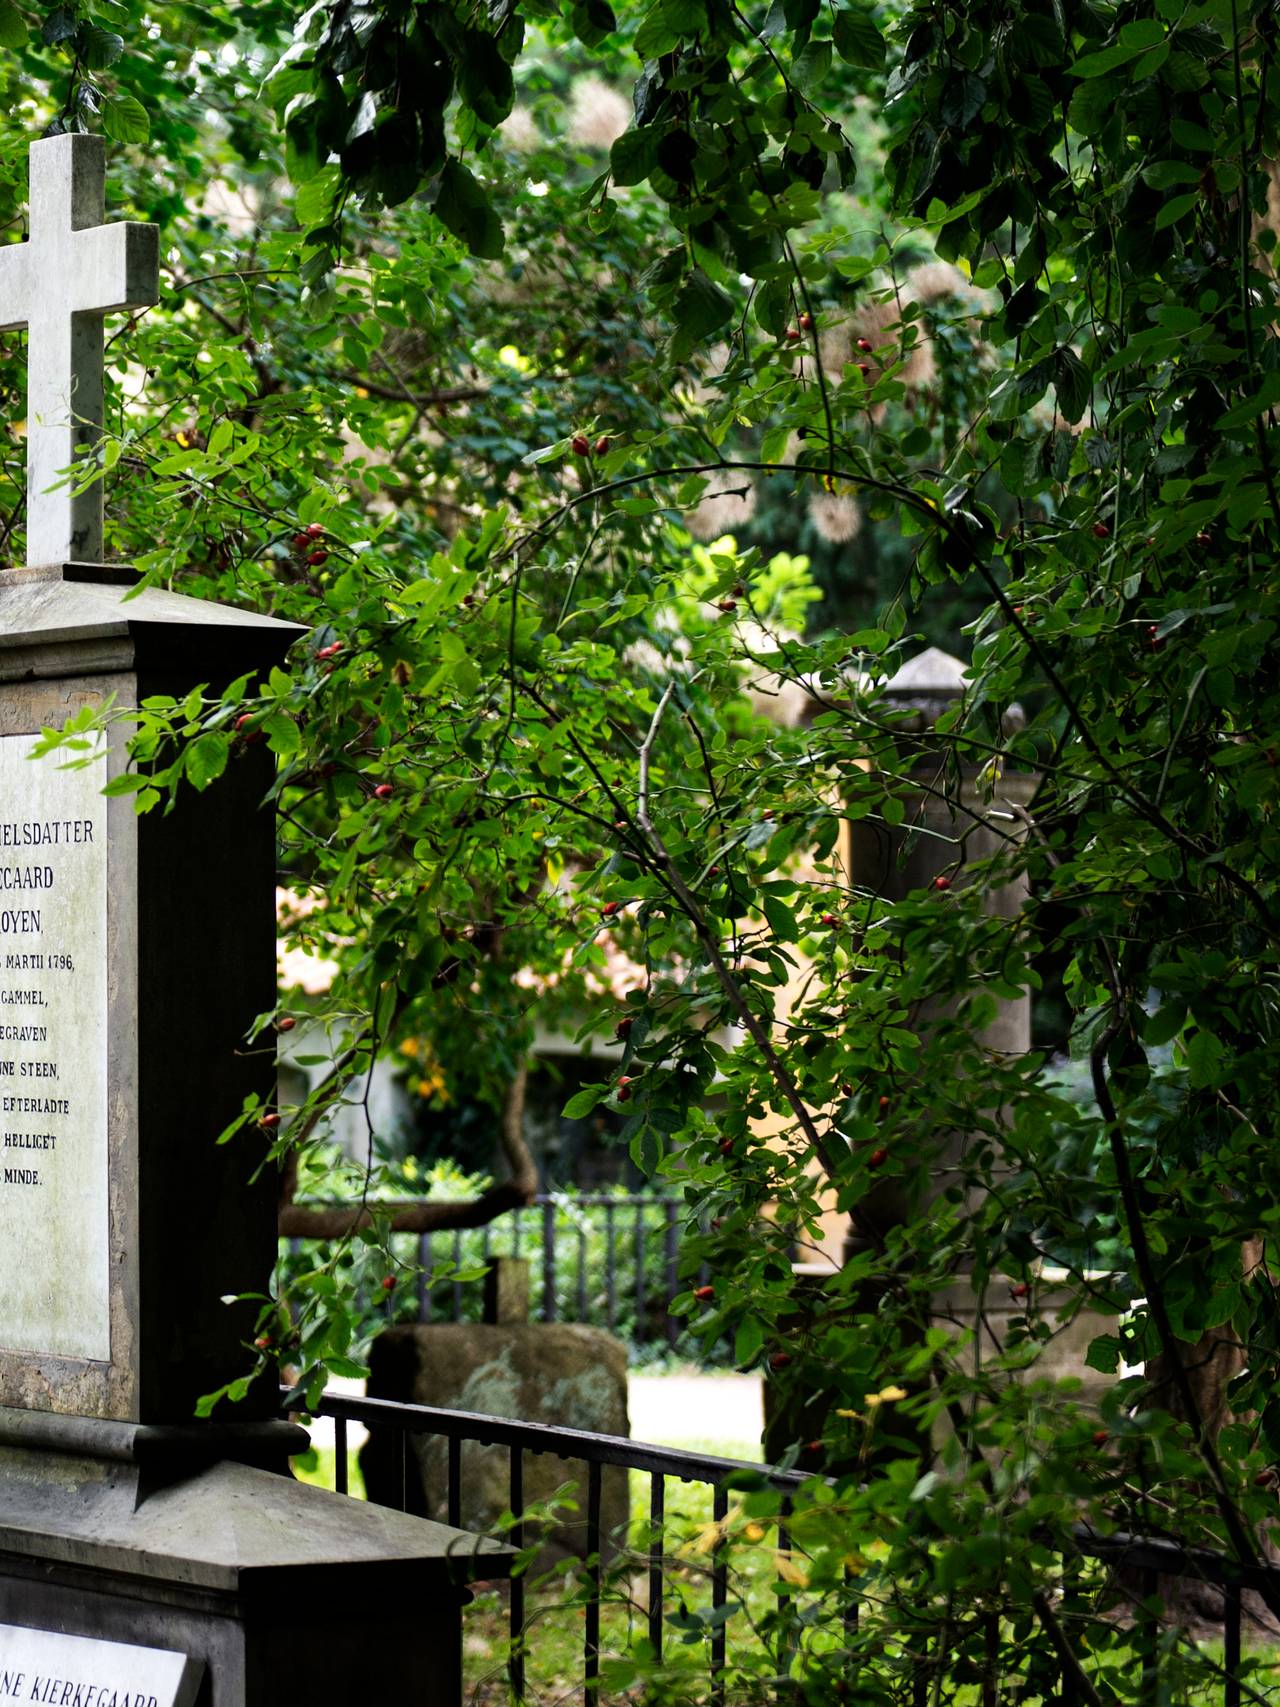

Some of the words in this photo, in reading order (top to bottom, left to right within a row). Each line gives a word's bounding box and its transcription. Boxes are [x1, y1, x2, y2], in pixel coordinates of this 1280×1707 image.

[6, 955, 44, 970] MARTII
[48, 954, 75, 972] 1796,
[1, 990, 49, 1008] GAMMEL,
[20, 1062, 60, 1080] STEEN,
[3, 1097, 70, 1114] EFTERLADTE
[4, 1133, 57, 1150] HELLIGET
[4, 1169, 43, 1186] MINDE.
